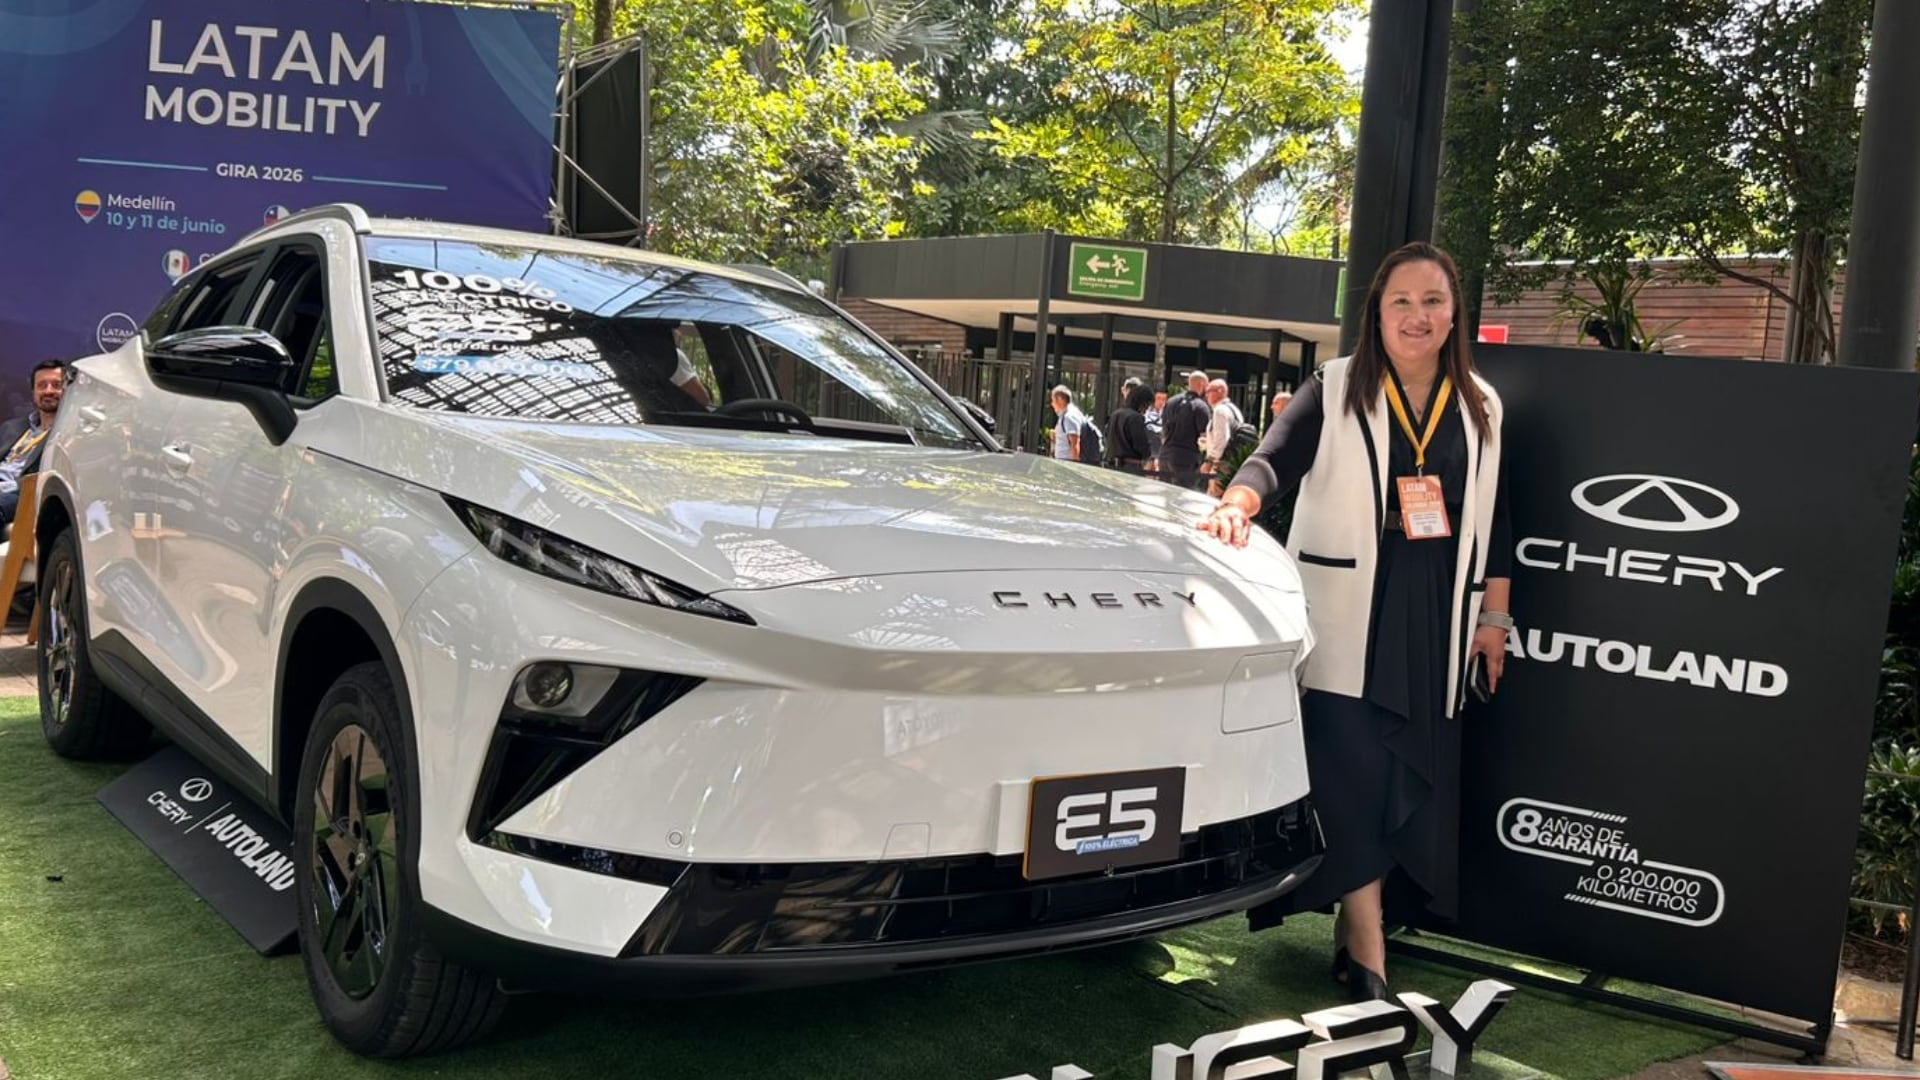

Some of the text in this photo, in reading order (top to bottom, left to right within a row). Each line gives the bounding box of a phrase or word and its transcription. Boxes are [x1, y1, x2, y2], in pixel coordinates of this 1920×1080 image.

[147, 19, 387, 89] LATAM
[144, 85, 381, 138] MOBILITY
[216, 162, 303, 183] GIRA 2026
[107, 193, 176, 212] Medellín
[107, 211, 226, 234] 10 y 11 de junio
[393, 268, 558, 299] 100%
[1515, 536, 1785, 596] CHERY
[992, 590, 1198, 609] CHERY
[1501, 625, 1789, 698] AUTOLAND
[147, 790, 193, 824] CHERY
[1055, 786, 1158, 852] E5
[1509, 808, 1625, 846] 8 AÑOS DE
[205, 813, 296, 891] AUTOLAND
[1537, 831, 1640, 865] GARANTÍA
[1576, 875, 1699, 914] KILÓMETROS
[1619, 867, 1701, 898] 200.000
[997, 978, 1518, 1080] ERY
